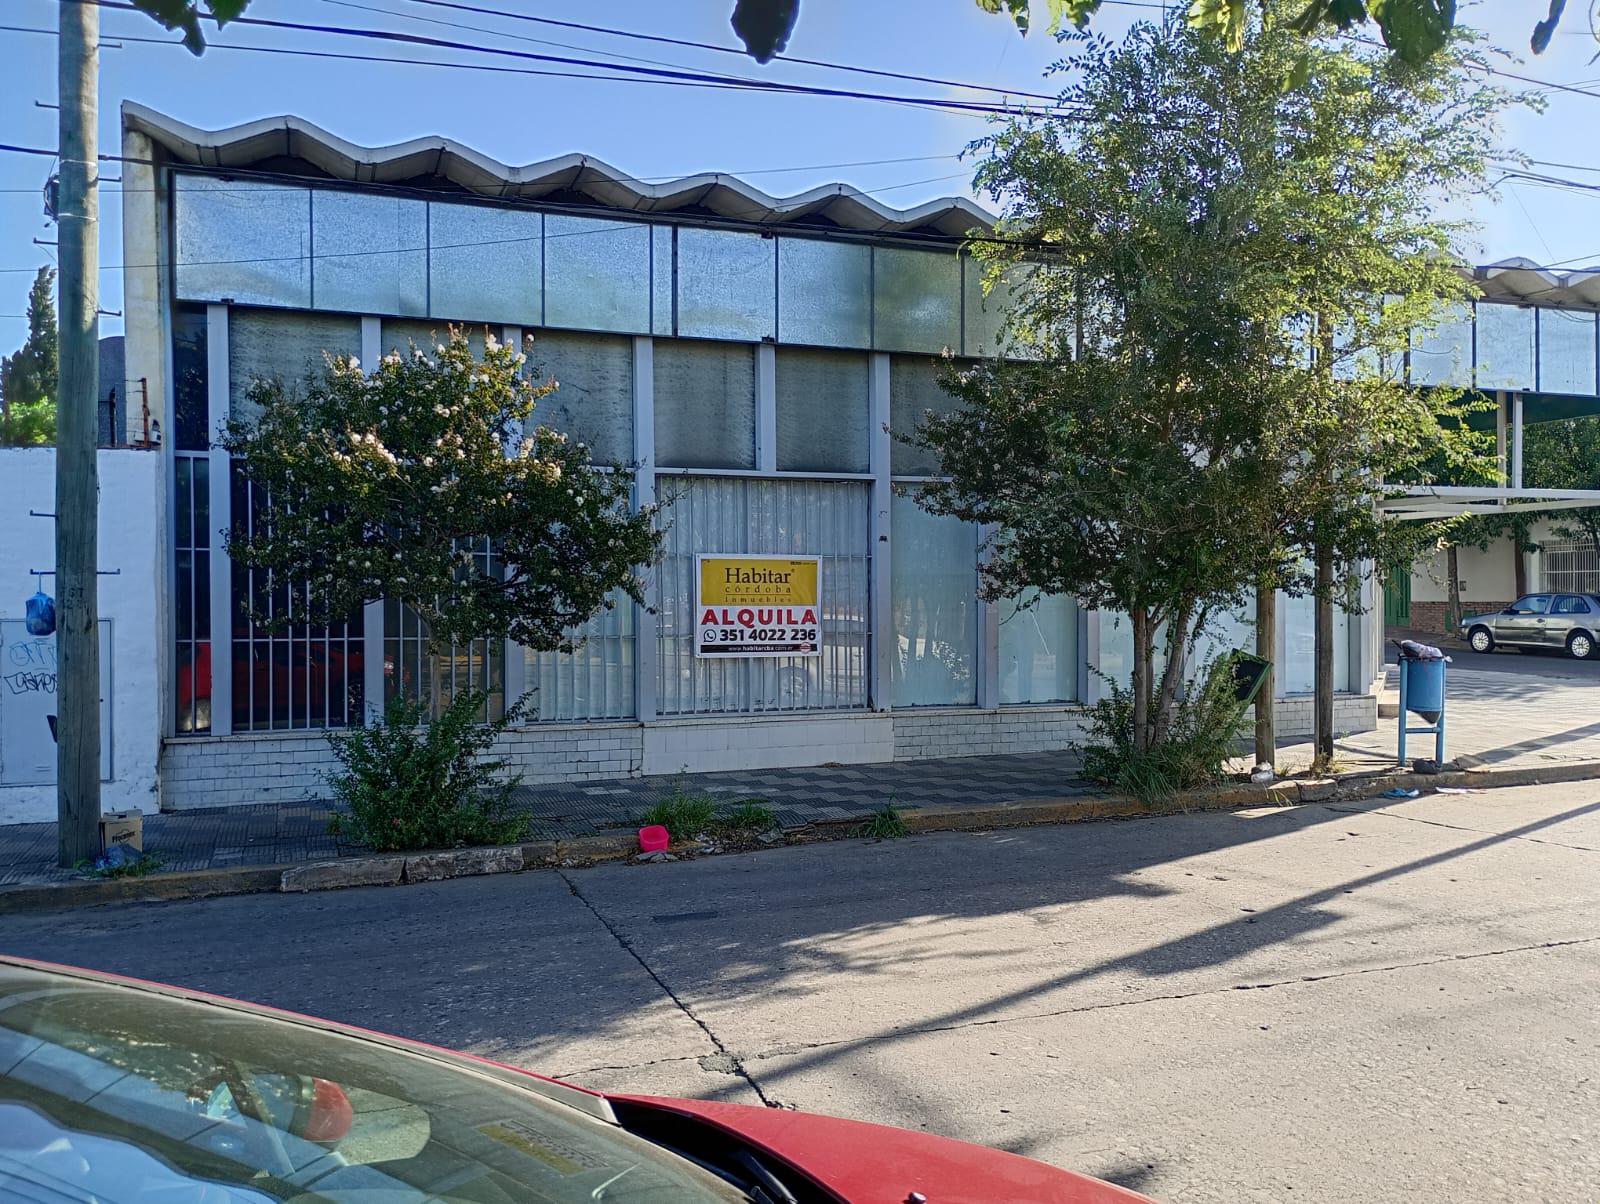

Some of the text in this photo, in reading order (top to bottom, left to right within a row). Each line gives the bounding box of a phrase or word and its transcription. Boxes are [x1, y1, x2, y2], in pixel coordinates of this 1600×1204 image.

[725, 568, 791, 584] Habitar
[701, 609, 817, 629] ALQUILA
[720, 629, 816, 641] 351 4022 236
